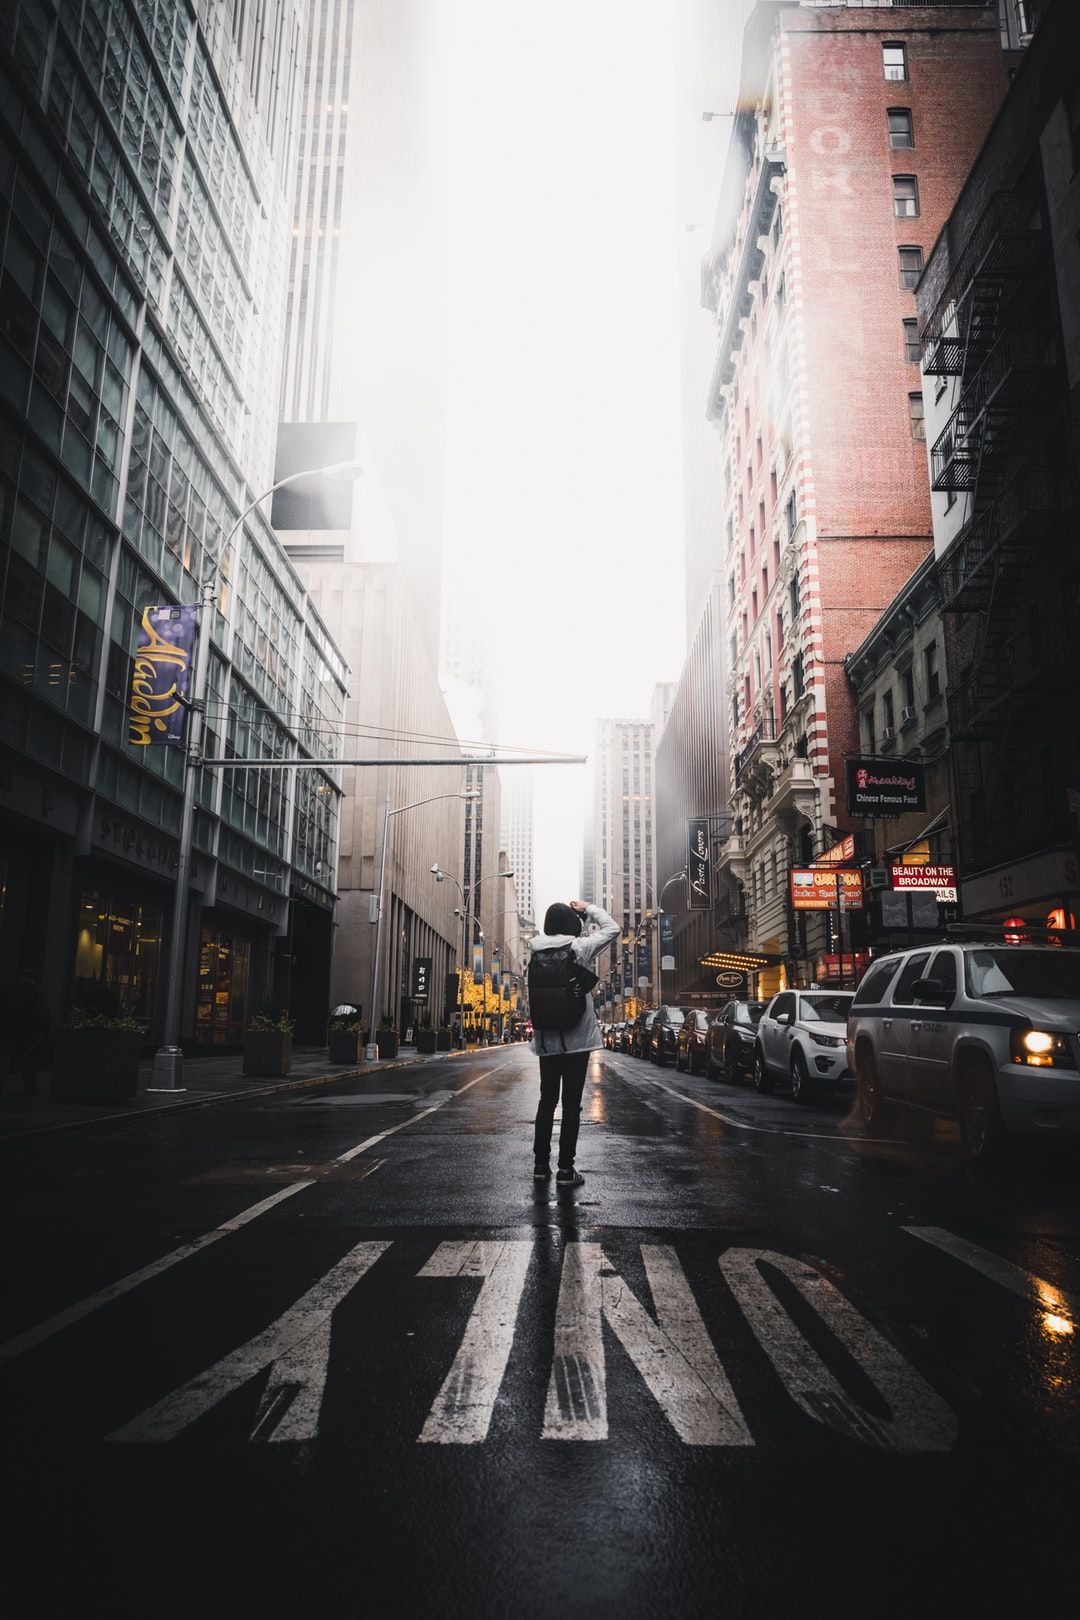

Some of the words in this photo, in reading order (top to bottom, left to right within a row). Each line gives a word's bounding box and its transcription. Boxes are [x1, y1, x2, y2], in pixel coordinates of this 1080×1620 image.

[856, 793, 879, 802] Chinese
[880, 794, 902, 803] Famous
[903, 795, 918, 804] Food
[690, 830, 708, 862] Lovers
[690, 863, 709, 897] Pasta
[892, 867, 923, 876] BEAUTY
[925, 867, 937, 876] ON
[938, 867, 954, 876] THE
[898, 877, 949, 886] BROADWAY
[102, 1240, 959, 1453] ONLY
